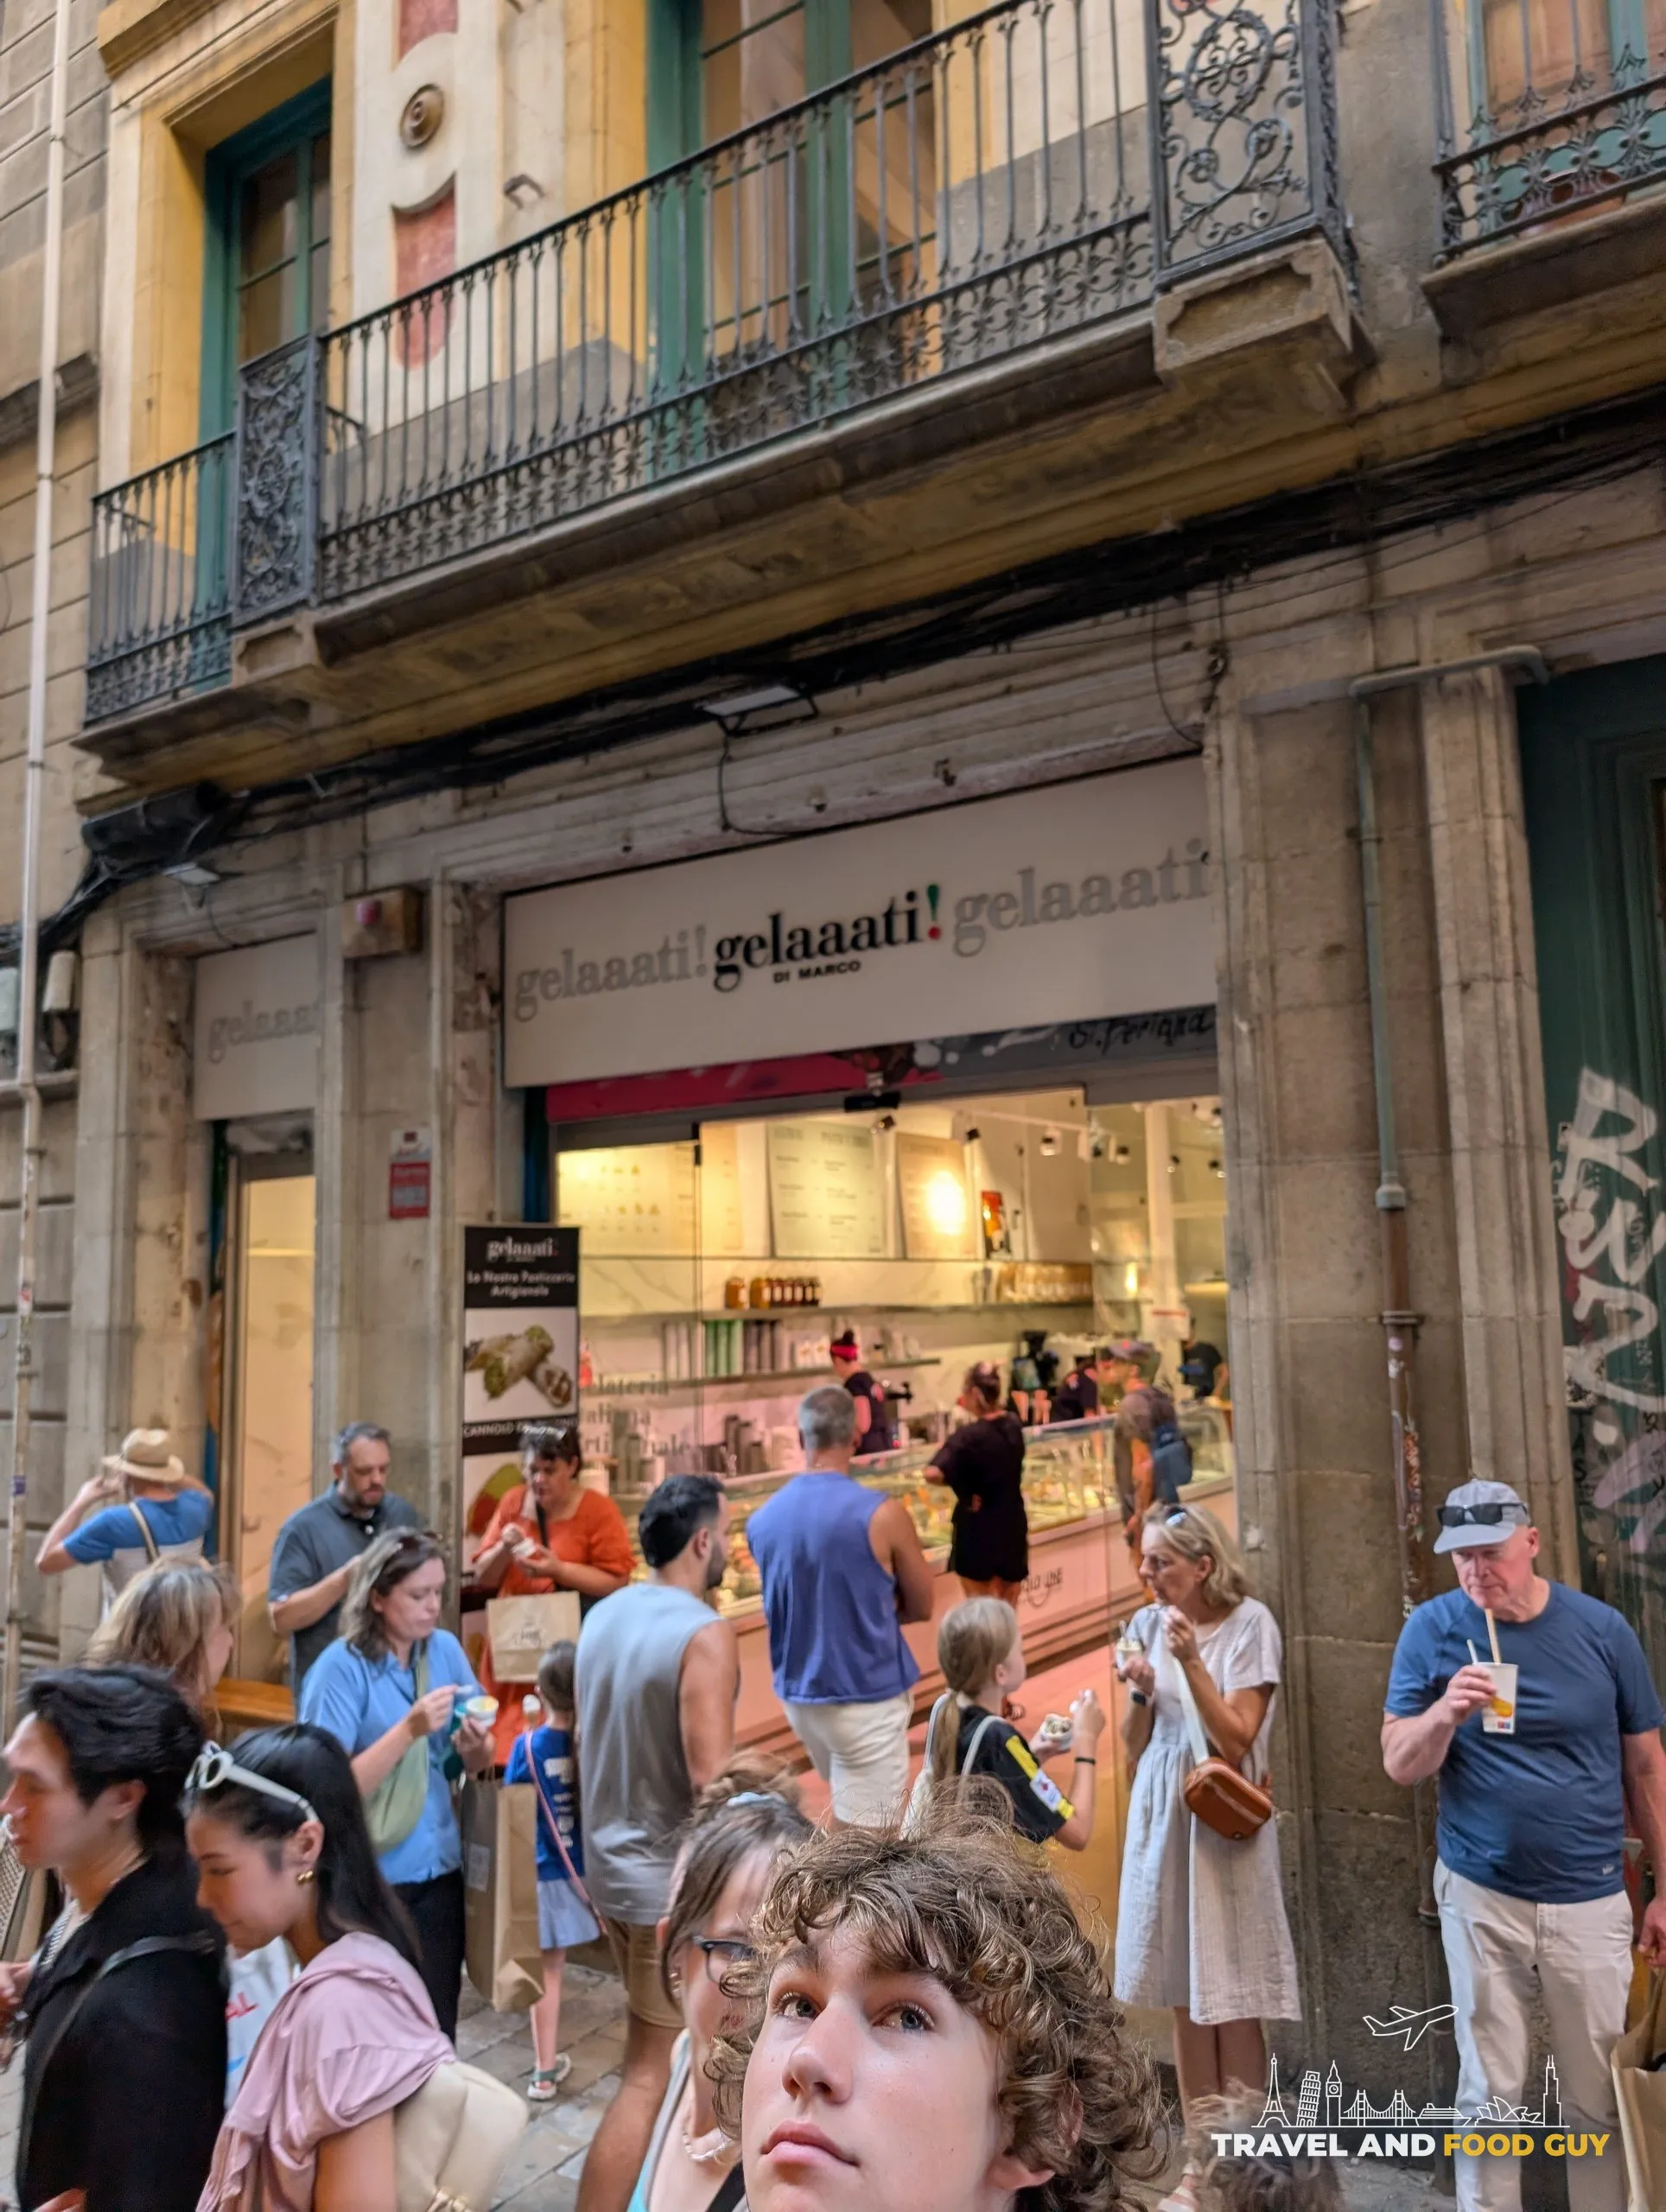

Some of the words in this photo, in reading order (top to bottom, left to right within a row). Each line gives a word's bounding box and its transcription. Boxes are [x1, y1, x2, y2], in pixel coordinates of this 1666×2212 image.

[513, 925, 709, 1023] gelaaati!
[711, 883, 943, 993] gelaaati!
[773, 970, 791, 984] DI
[798, 959, 862, 981] MARCO
